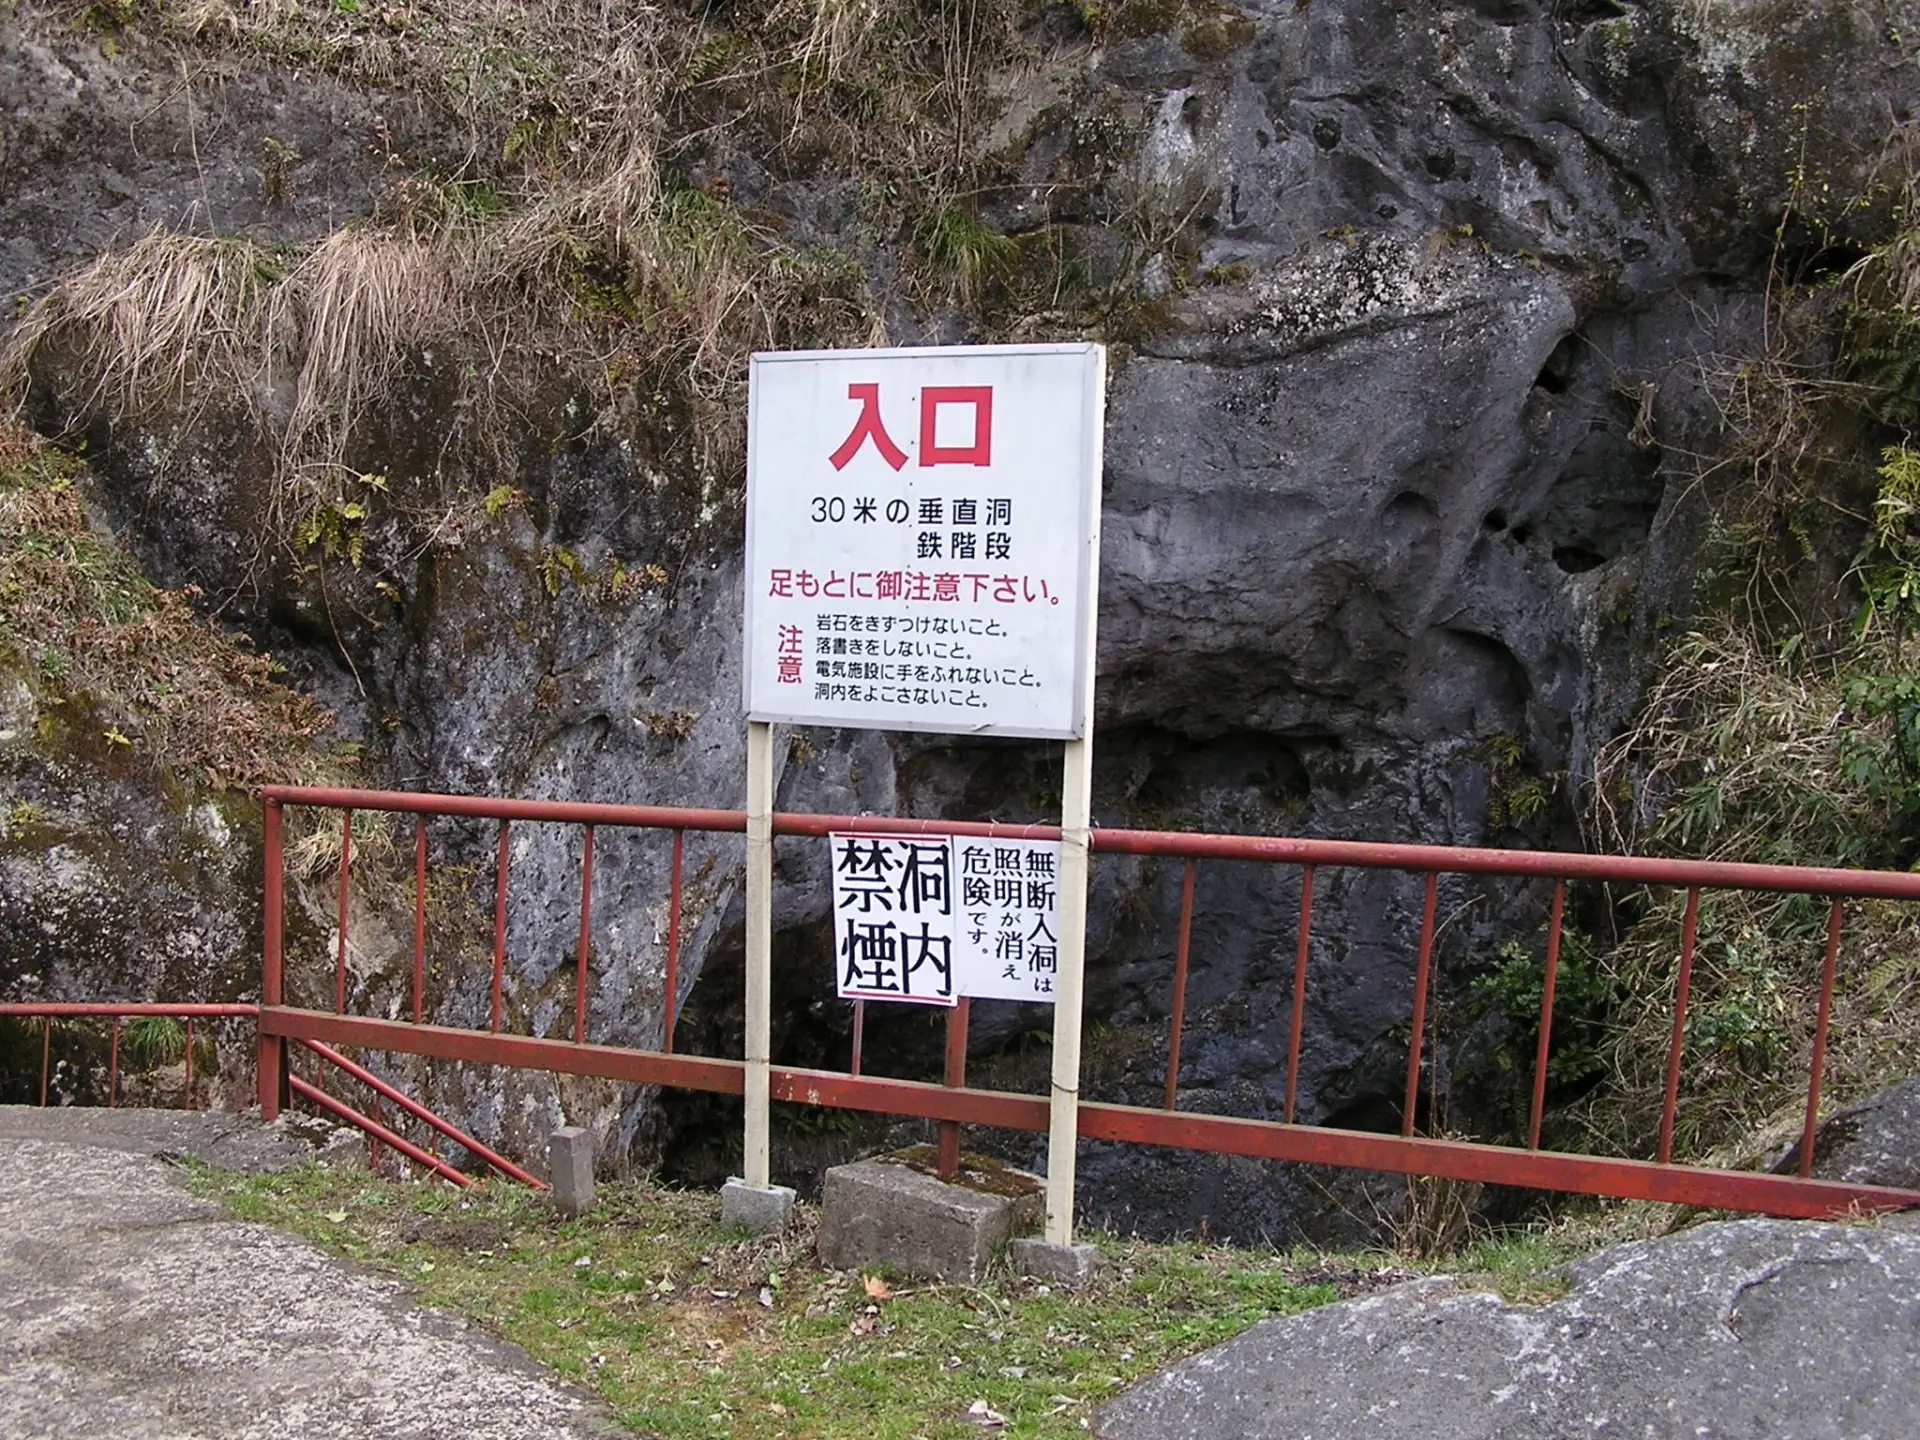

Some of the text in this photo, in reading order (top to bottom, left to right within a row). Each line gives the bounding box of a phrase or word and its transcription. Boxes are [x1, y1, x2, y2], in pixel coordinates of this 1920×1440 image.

[828, 382, 994, 472] 入口
[811, 496, 1012, 527] 30米の垂直洞
[917, 531, 1012, 560] 鉄階段
[768, 569, 1059, 606] 足もとに御注意下さい。
[815, 636, 972, 661] 落書きをしないこと。
[816, 614, 1008, 638] 岩石をきずつけないこと。
[777, 624, 803, 684] 注意
[815, 660, 1042, 688] 電気施設に手をふれないこと。
[814, 683, 988, 709] 洞内をよごさないこと。
[837, 839, 900, 992] 禁煙
[894, 841, 952, 996] 洞内
[961, 845, 992, 955] 危険です。
[993, 847, 1024, 981] 照明が消え
[1025, 849, 1057, 993] 無断入洞は
